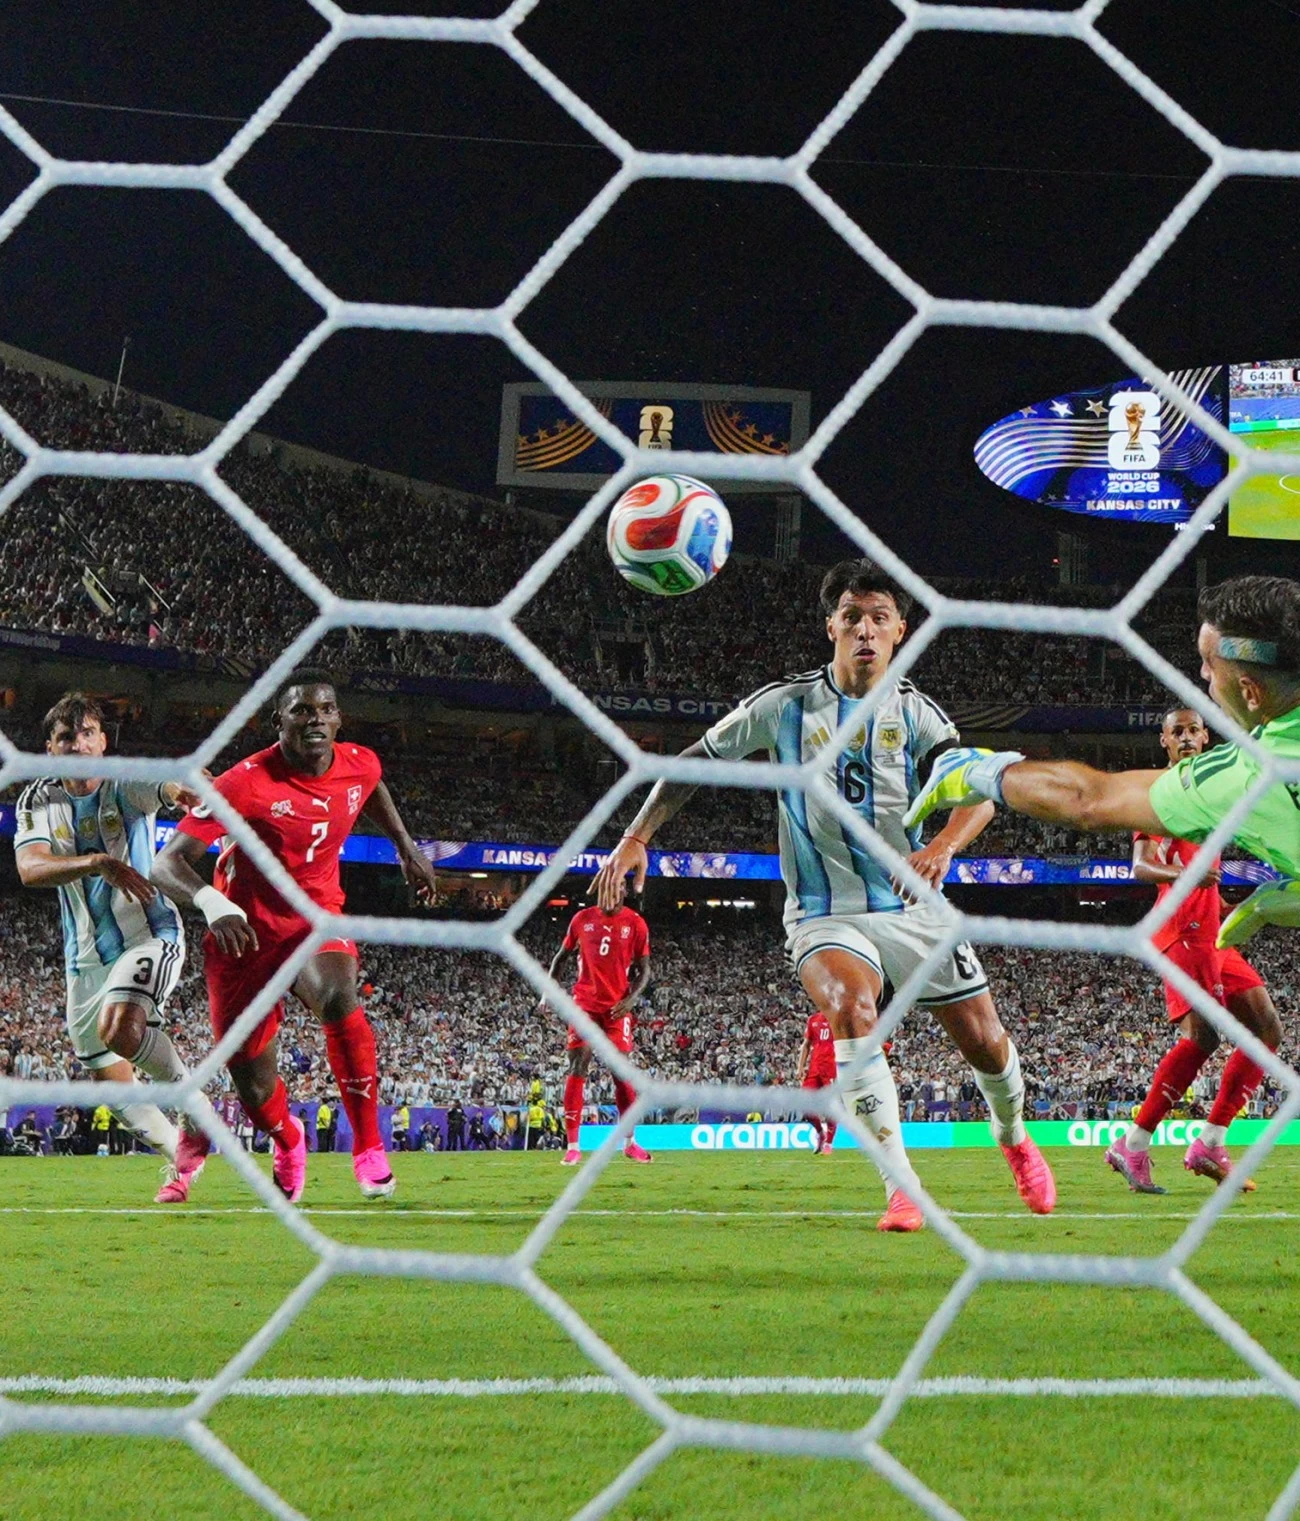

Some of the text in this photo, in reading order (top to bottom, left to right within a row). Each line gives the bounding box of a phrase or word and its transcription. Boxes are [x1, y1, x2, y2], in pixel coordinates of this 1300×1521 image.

[1250, 371, 1284, 382] 64:41
[1123, 453, 1146, 463] FIFA
[1107, 472, 1160, 480] WORLD CUP
[1107, 481, 1160, 493] 2026
[1086, 499, 1181, 511] KANSAS CITY
[844, 761, 866, 804] 6
[305, 822, 329, 863] 7
[600, 936, 611, 957] 6
[133, 957, 153, 985] 3
[623, 1016, 631, 1037] 6
[820, 1028, 830, 1040] 10
[855, 1094, 883, 1116] AFA
